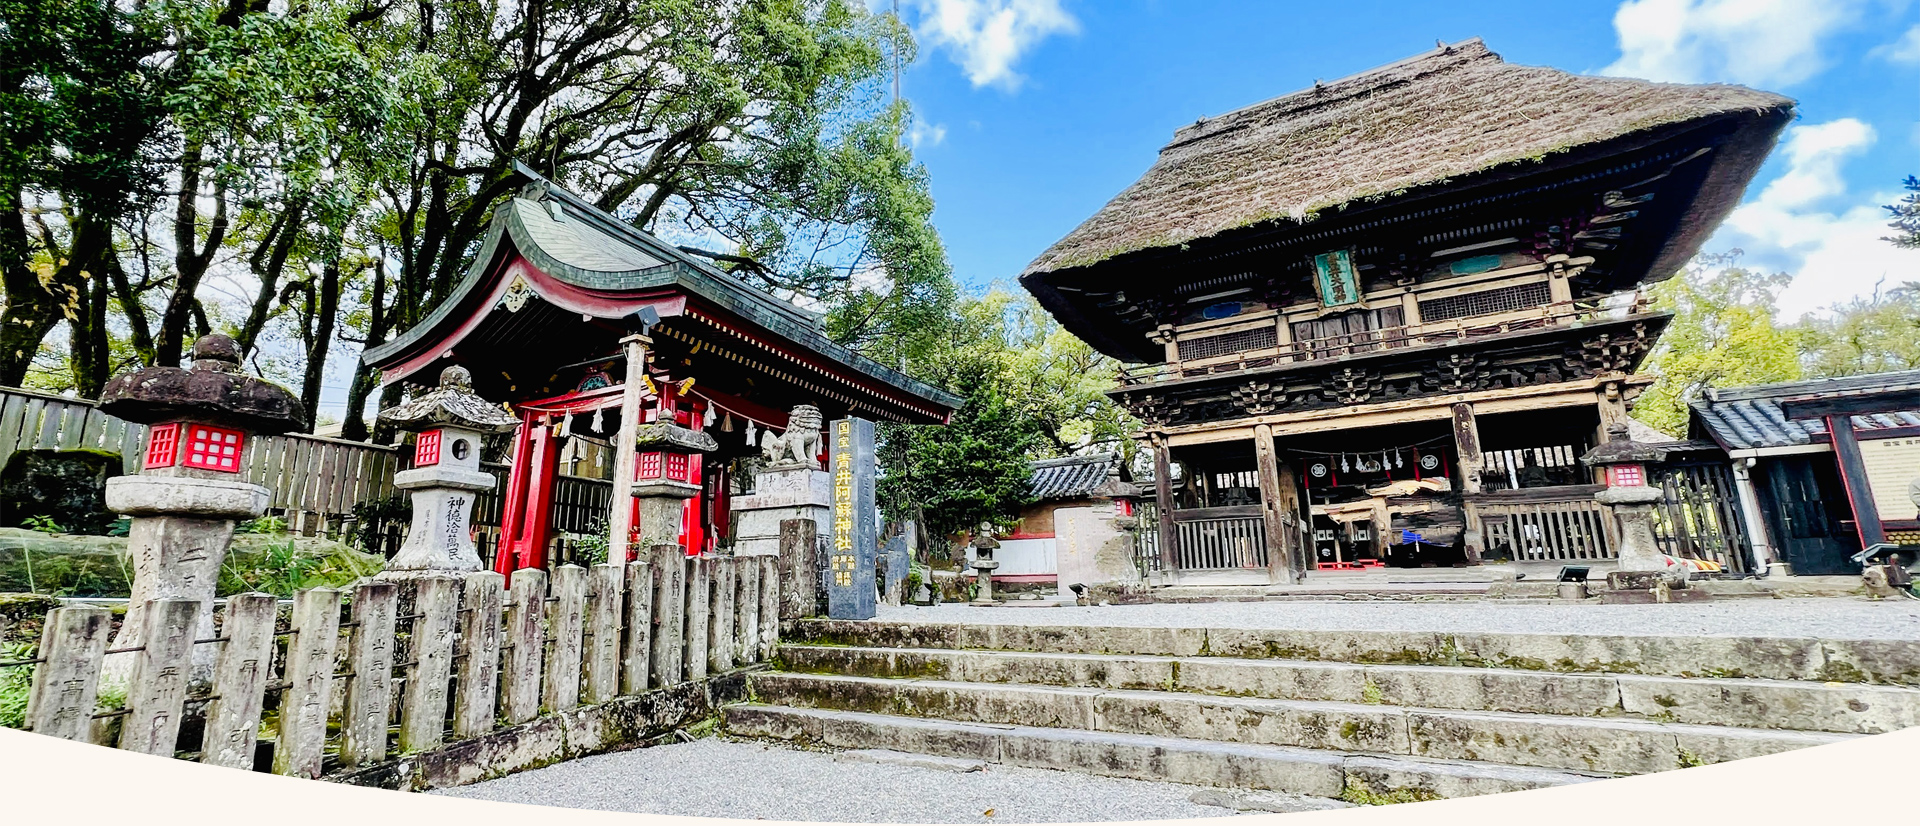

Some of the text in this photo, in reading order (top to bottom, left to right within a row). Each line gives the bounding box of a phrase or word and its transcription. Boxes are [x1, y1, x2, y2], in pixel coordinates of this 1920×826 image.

[835, 421, 852, 550] 国宝 青井阿蘇神社
